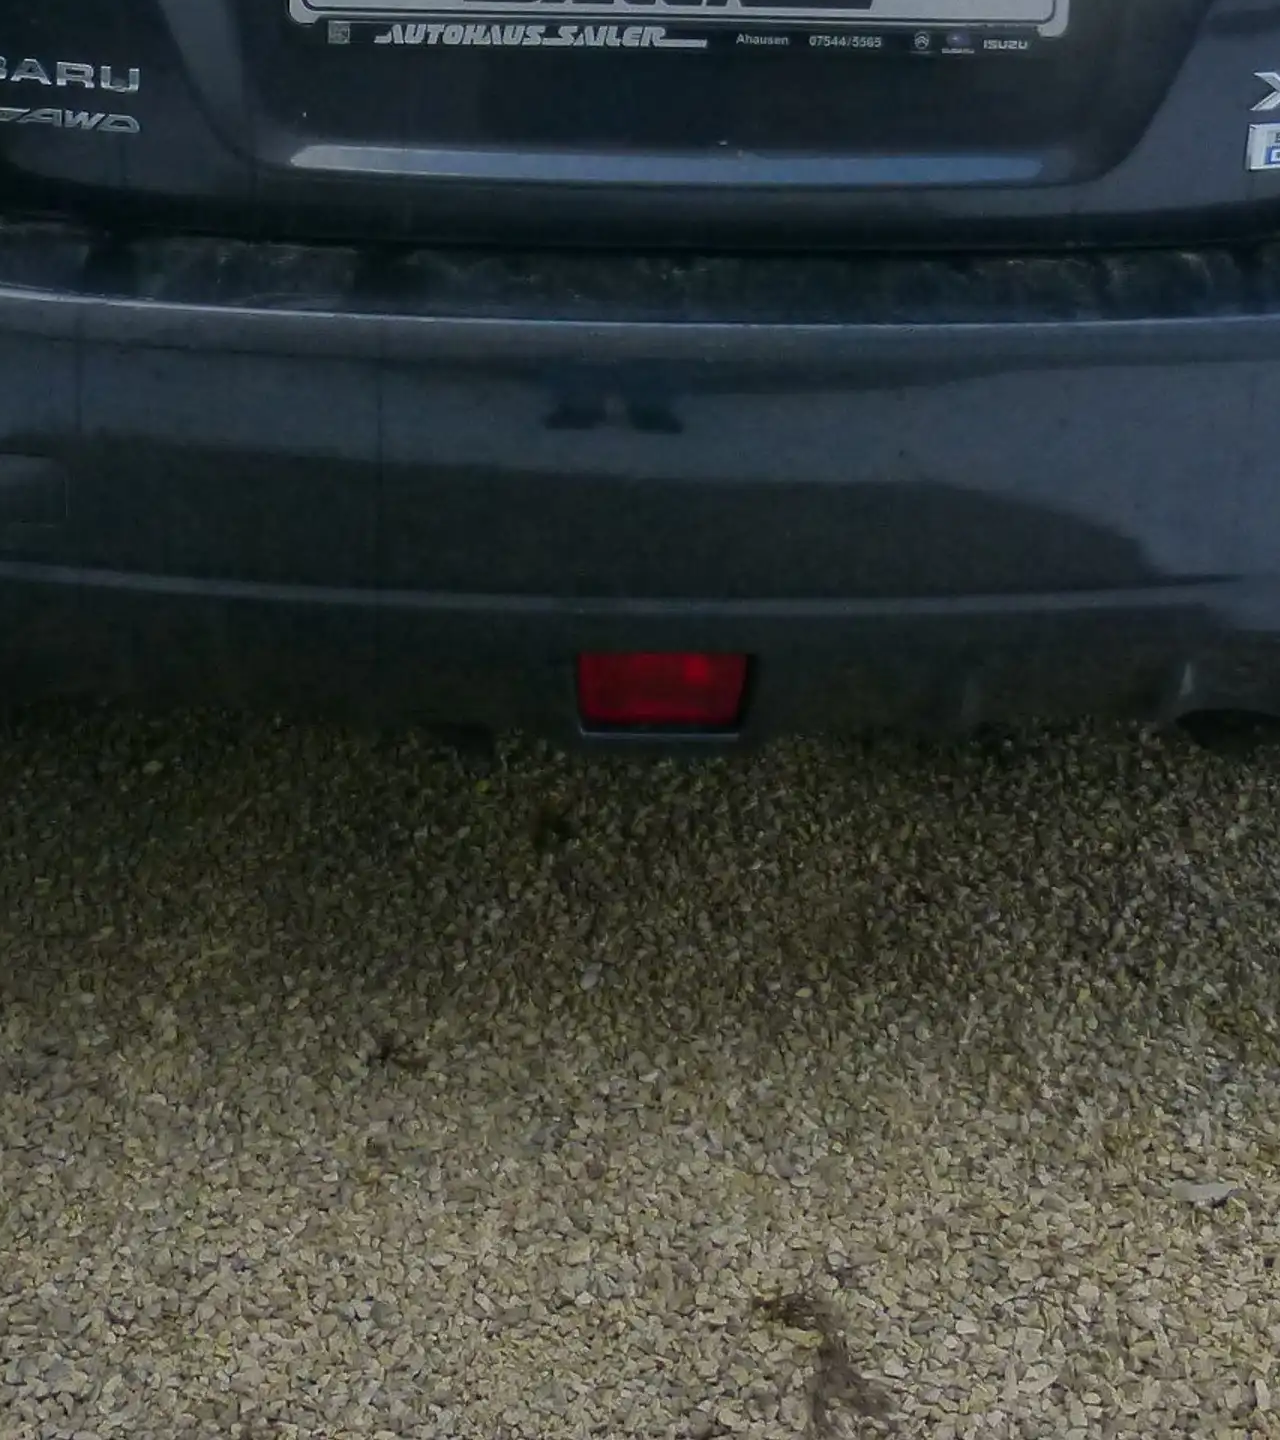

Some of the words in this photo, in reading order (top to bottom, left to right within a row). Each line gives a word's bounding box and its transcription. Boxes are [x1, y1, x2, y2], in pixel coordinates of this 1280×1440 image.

[373, 24, 545, 46] AUTOHAUS
[545, 26, 709, 48] SAILER
[736, 33, 790, 46] Ahausen
[983, 39, 1029, 50] ISUZU
[19, 108, 141, 134] AWD
